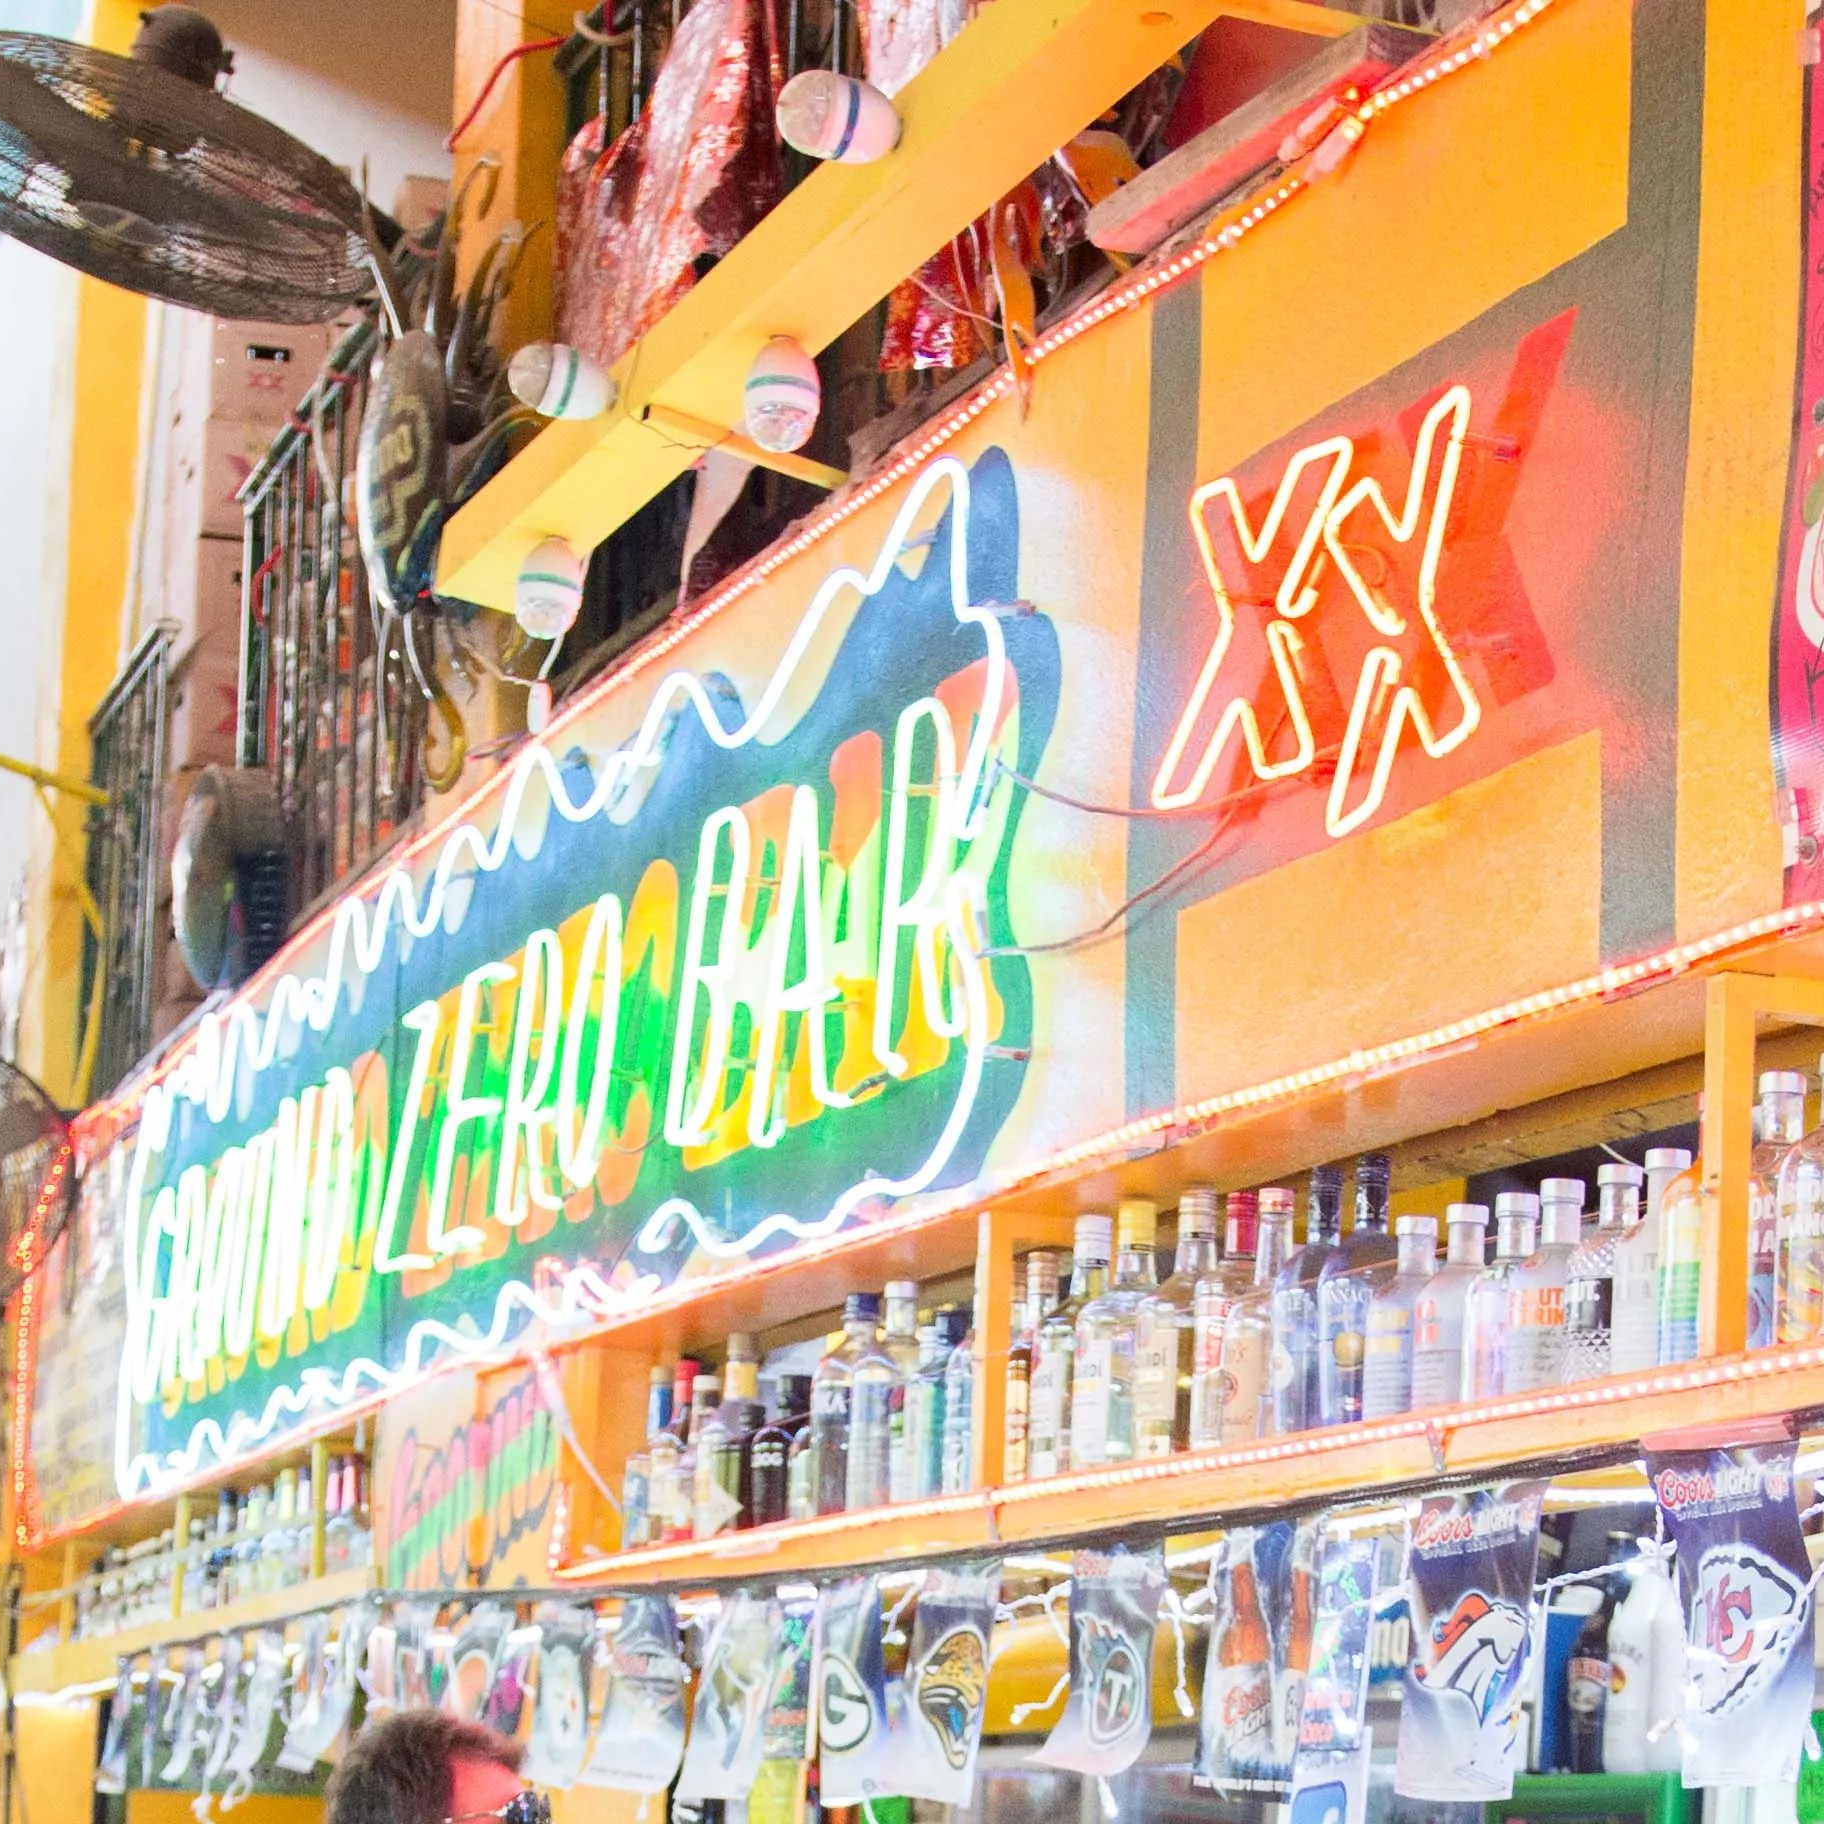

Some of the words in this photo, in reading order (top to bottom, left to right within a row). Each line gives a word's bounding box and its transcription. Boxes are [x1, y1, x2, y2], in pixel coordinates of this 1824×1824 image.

[129, 1057, 364, 1408] GROUND
[373, 890, 623, 1270] ZERO
[665, 697, 986, 1146] BAR
[1655, 1468, 1715, 1509] Coors
[1413, 1508, 1474, 1550] Coors
